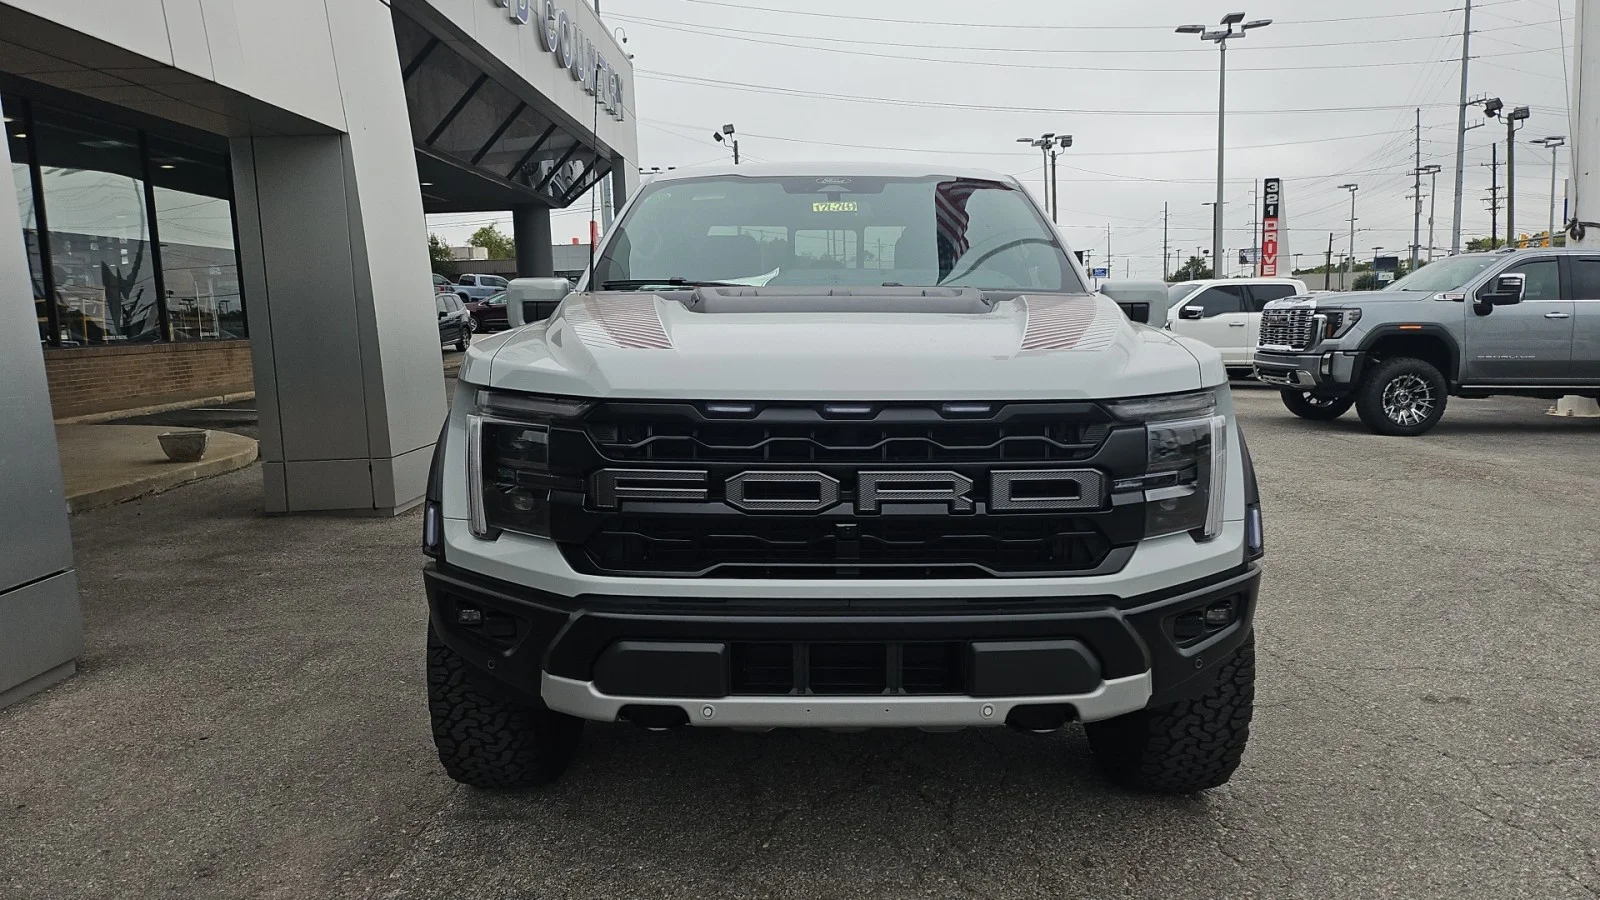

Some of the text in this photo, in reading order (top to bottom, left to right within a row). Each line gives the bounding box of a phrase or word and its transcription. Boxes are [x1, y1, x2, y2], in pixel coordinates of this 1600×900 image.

[537, 0, 623, 121] COUNTRY
[1266, 182, 1279, 215] 321
[1263, 221, 1278, 275] DRIVE
[595, 468, 1103, 512] FORD
